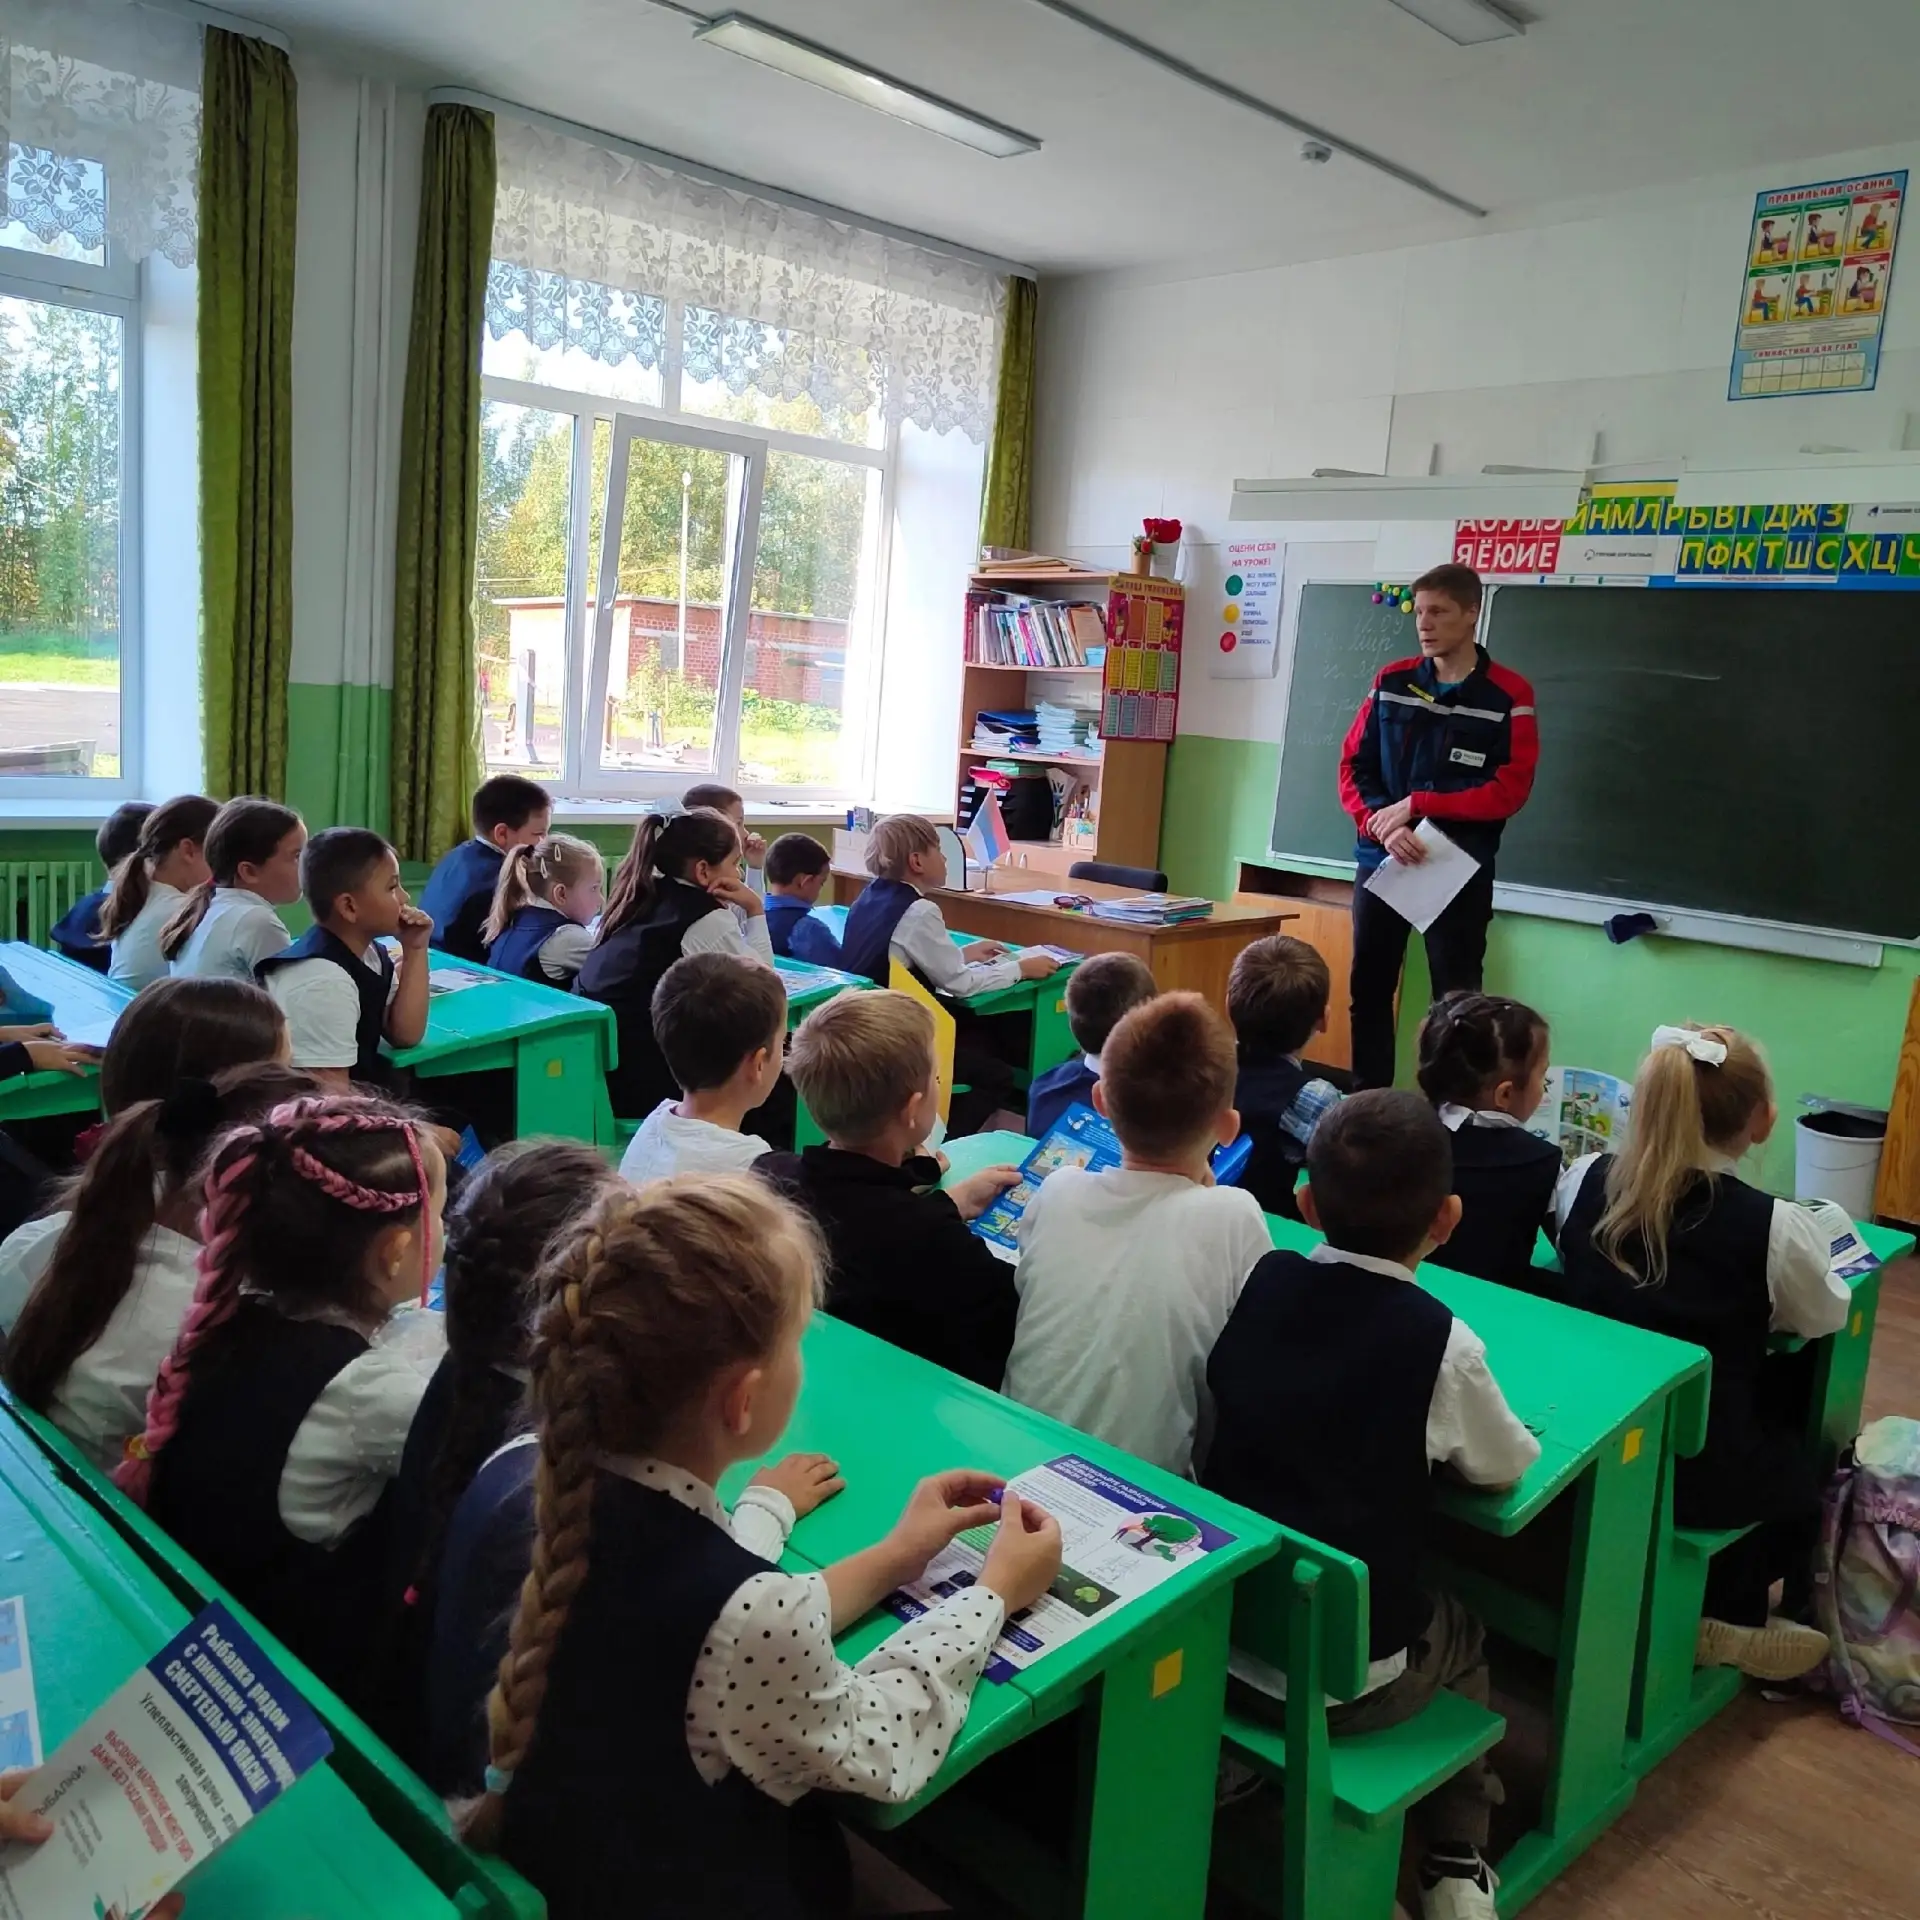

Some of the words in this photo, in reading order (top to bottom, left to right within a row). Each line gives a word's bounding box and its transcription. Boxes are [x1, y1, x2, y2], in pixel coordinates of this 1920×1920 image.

[1768, 187, 1845, 205] ПРАВИЛЬНАЯ
[1847, 178, 1894, 193] ОСАНКА
[1229, 544, 1255, 553] ОЦЕНИ
[1257, 543, 1276, 552] СЕБЯ
[1232, 559, 1241, 567] НА
[191, 1651, 248, 1717] линиями
[200, 1622, 257, 1689] Рыбалка
[245, 1682, 291, 1732] рядом
[163, 1657, 239, 1745] СМЕРТЕЛЬНО
[104, 1729, 141, 1771] ВЫСОКОЕ
[138, 1691, 205, 1778] Углепластиковая
[89, 1742, 117, 1770] ДАЖЕ
[111, 1766, 130, 1786] БЕЗ
